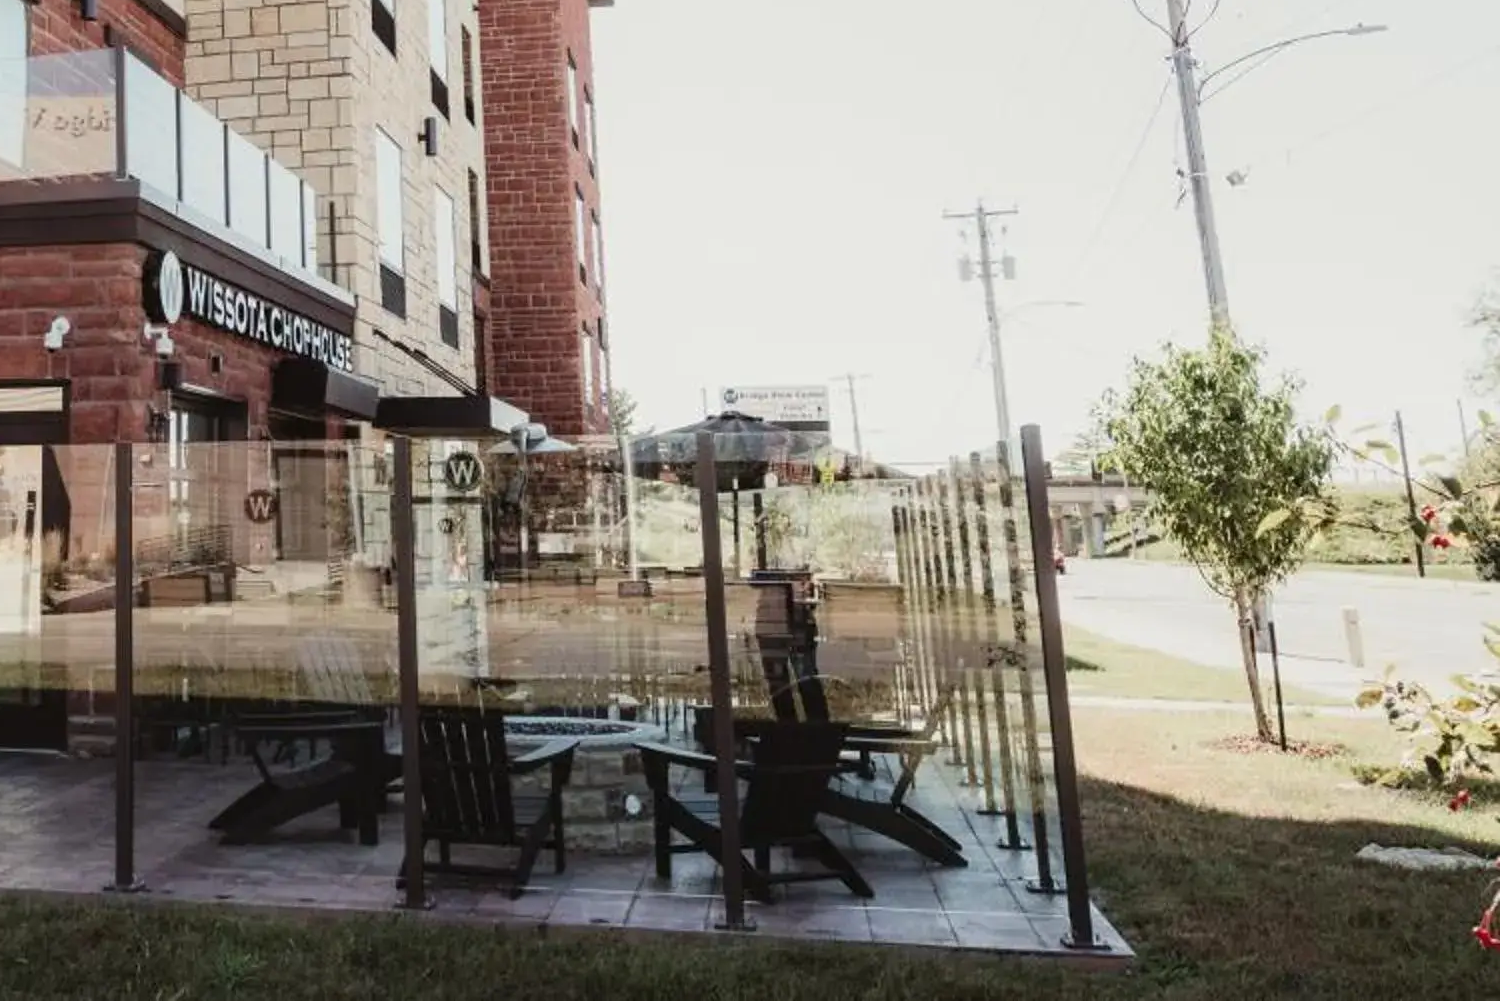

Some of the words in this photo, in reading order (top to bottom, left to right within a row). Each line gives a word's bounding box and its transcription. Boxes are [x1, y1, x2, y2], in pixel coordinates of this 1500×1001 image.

[186, 266, 269, 342] WISSOTA
[270, 310, 353, 371] CHOPHOUSE
[449, 460, 475, 485] W
[249, 495, 273, 519] W
